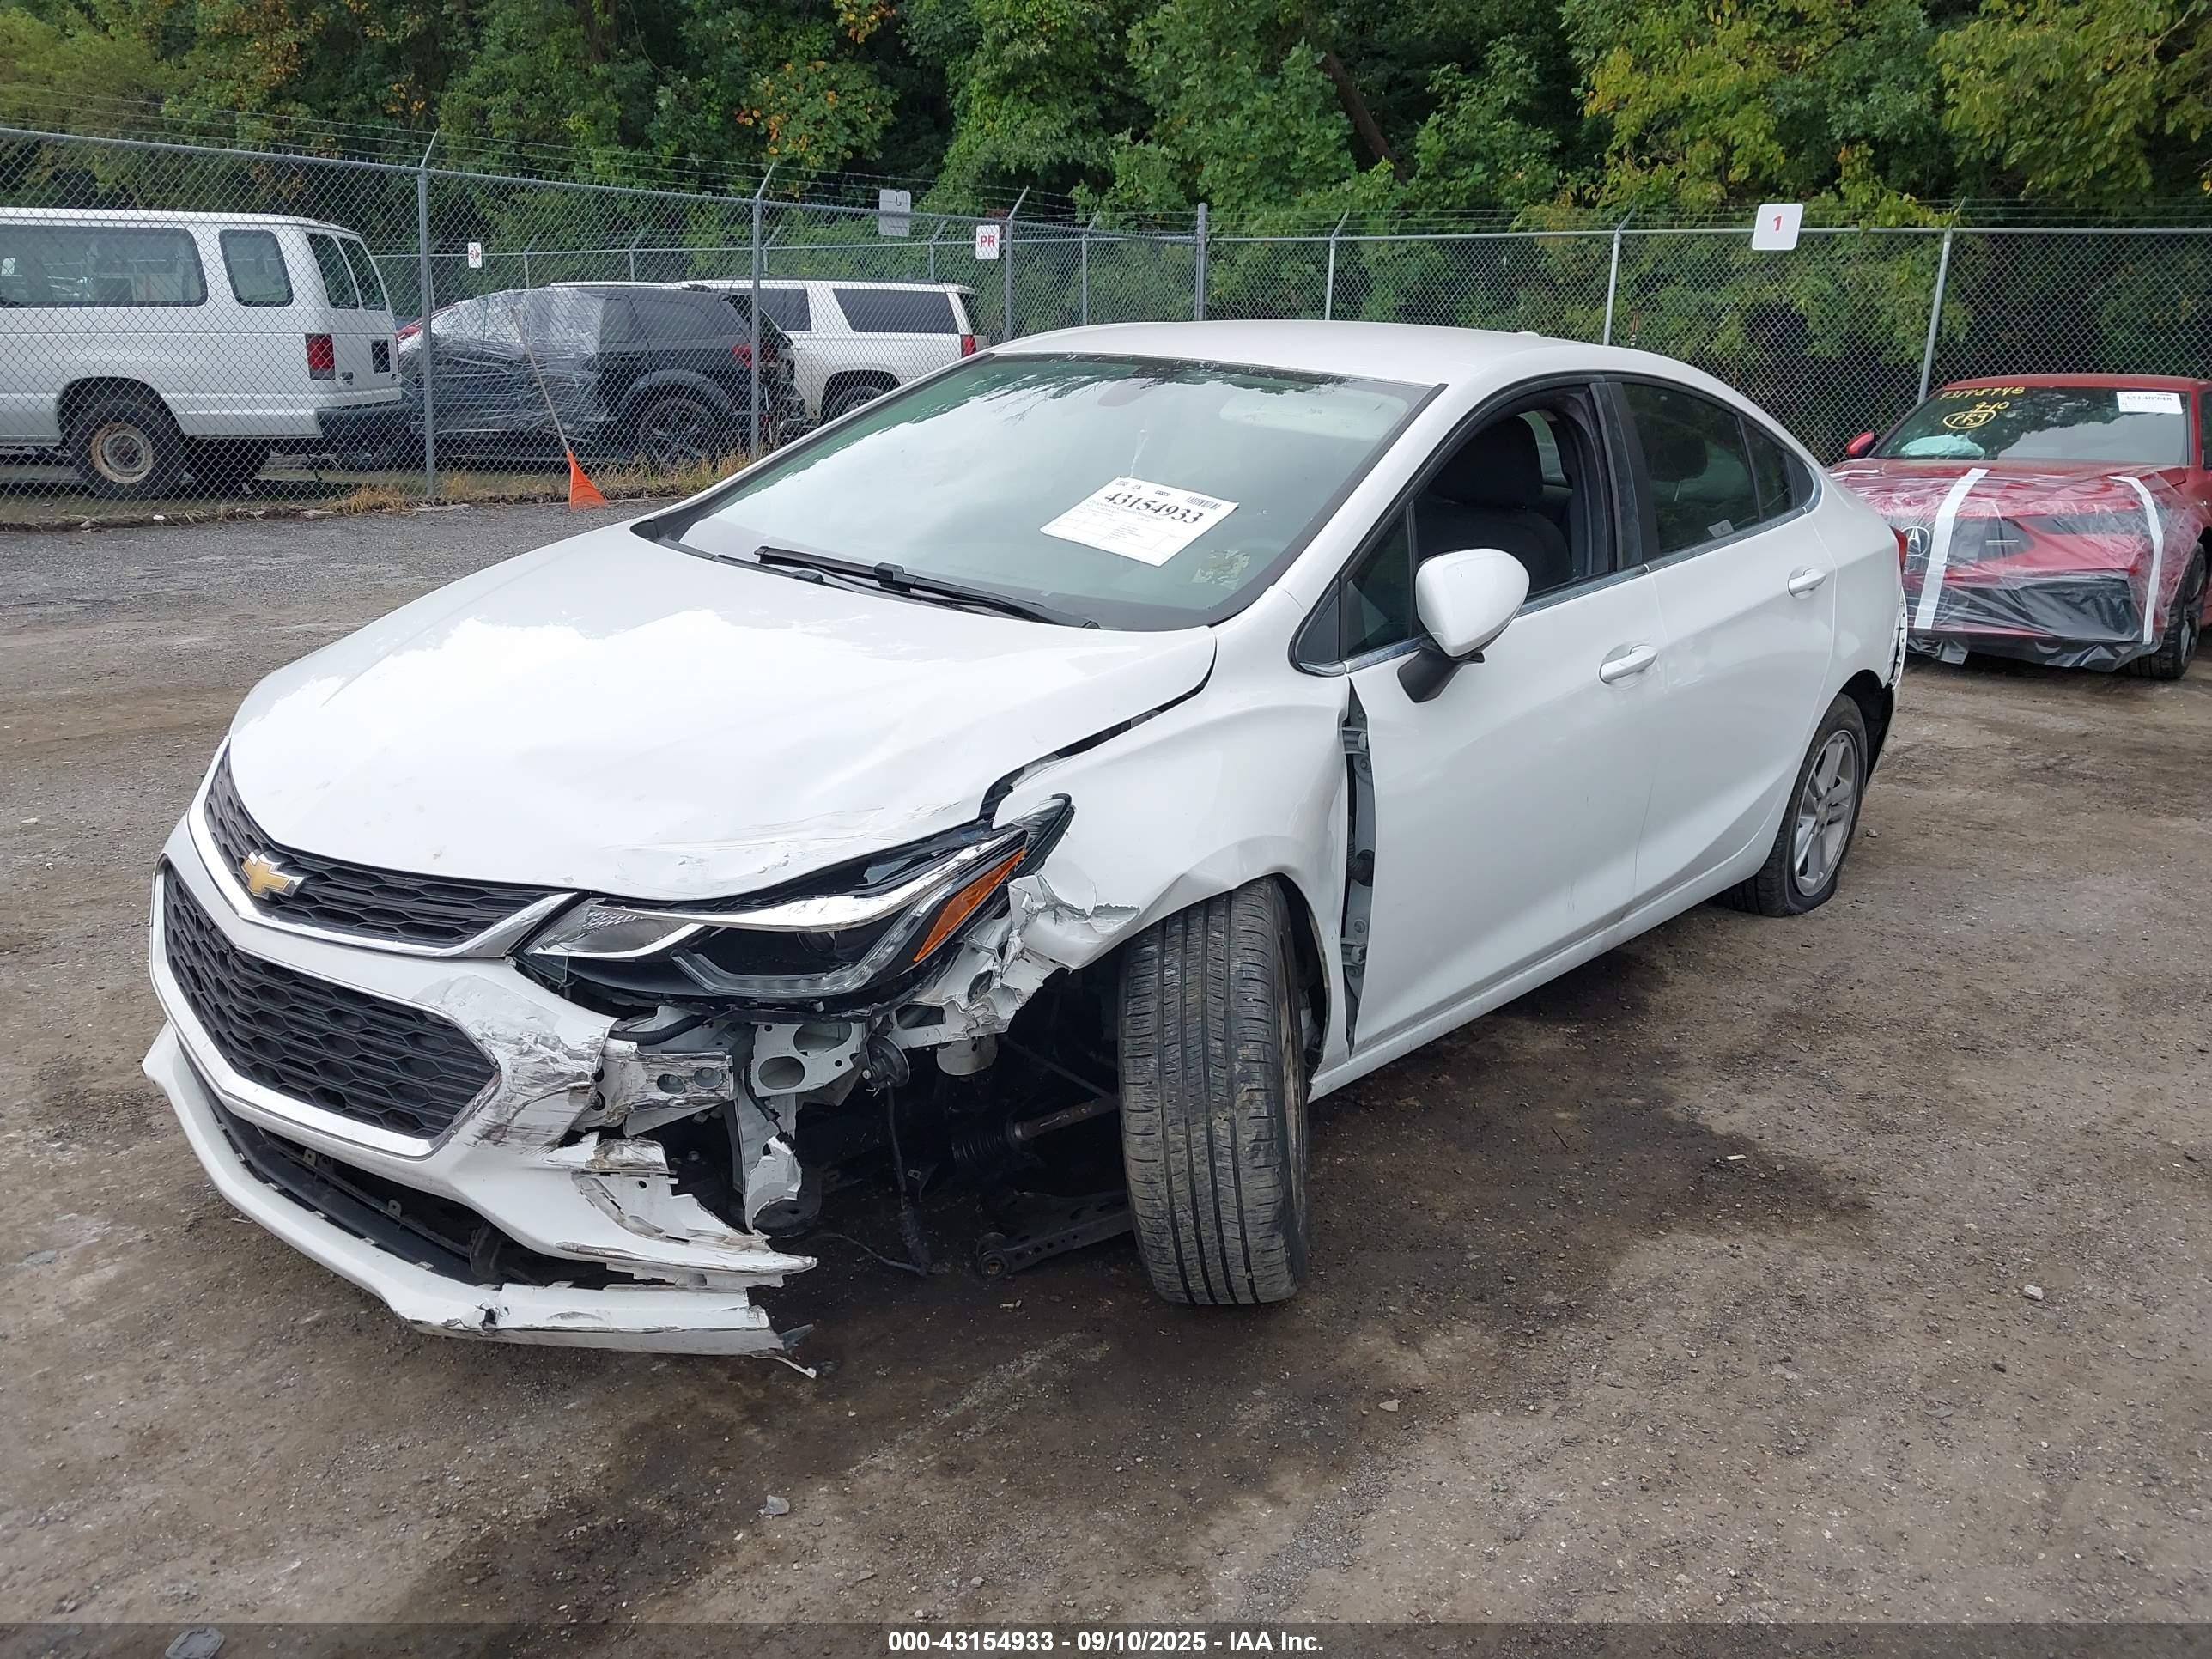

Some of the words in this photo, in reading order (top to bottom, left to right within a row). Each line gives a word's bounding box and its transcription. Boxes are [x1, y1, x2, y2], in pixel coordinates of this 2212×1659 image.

[1772, 216, 1783, 232] 1
[980, 234, 996, 247] PR
[1104, 492, 1204, 524] 43154933
